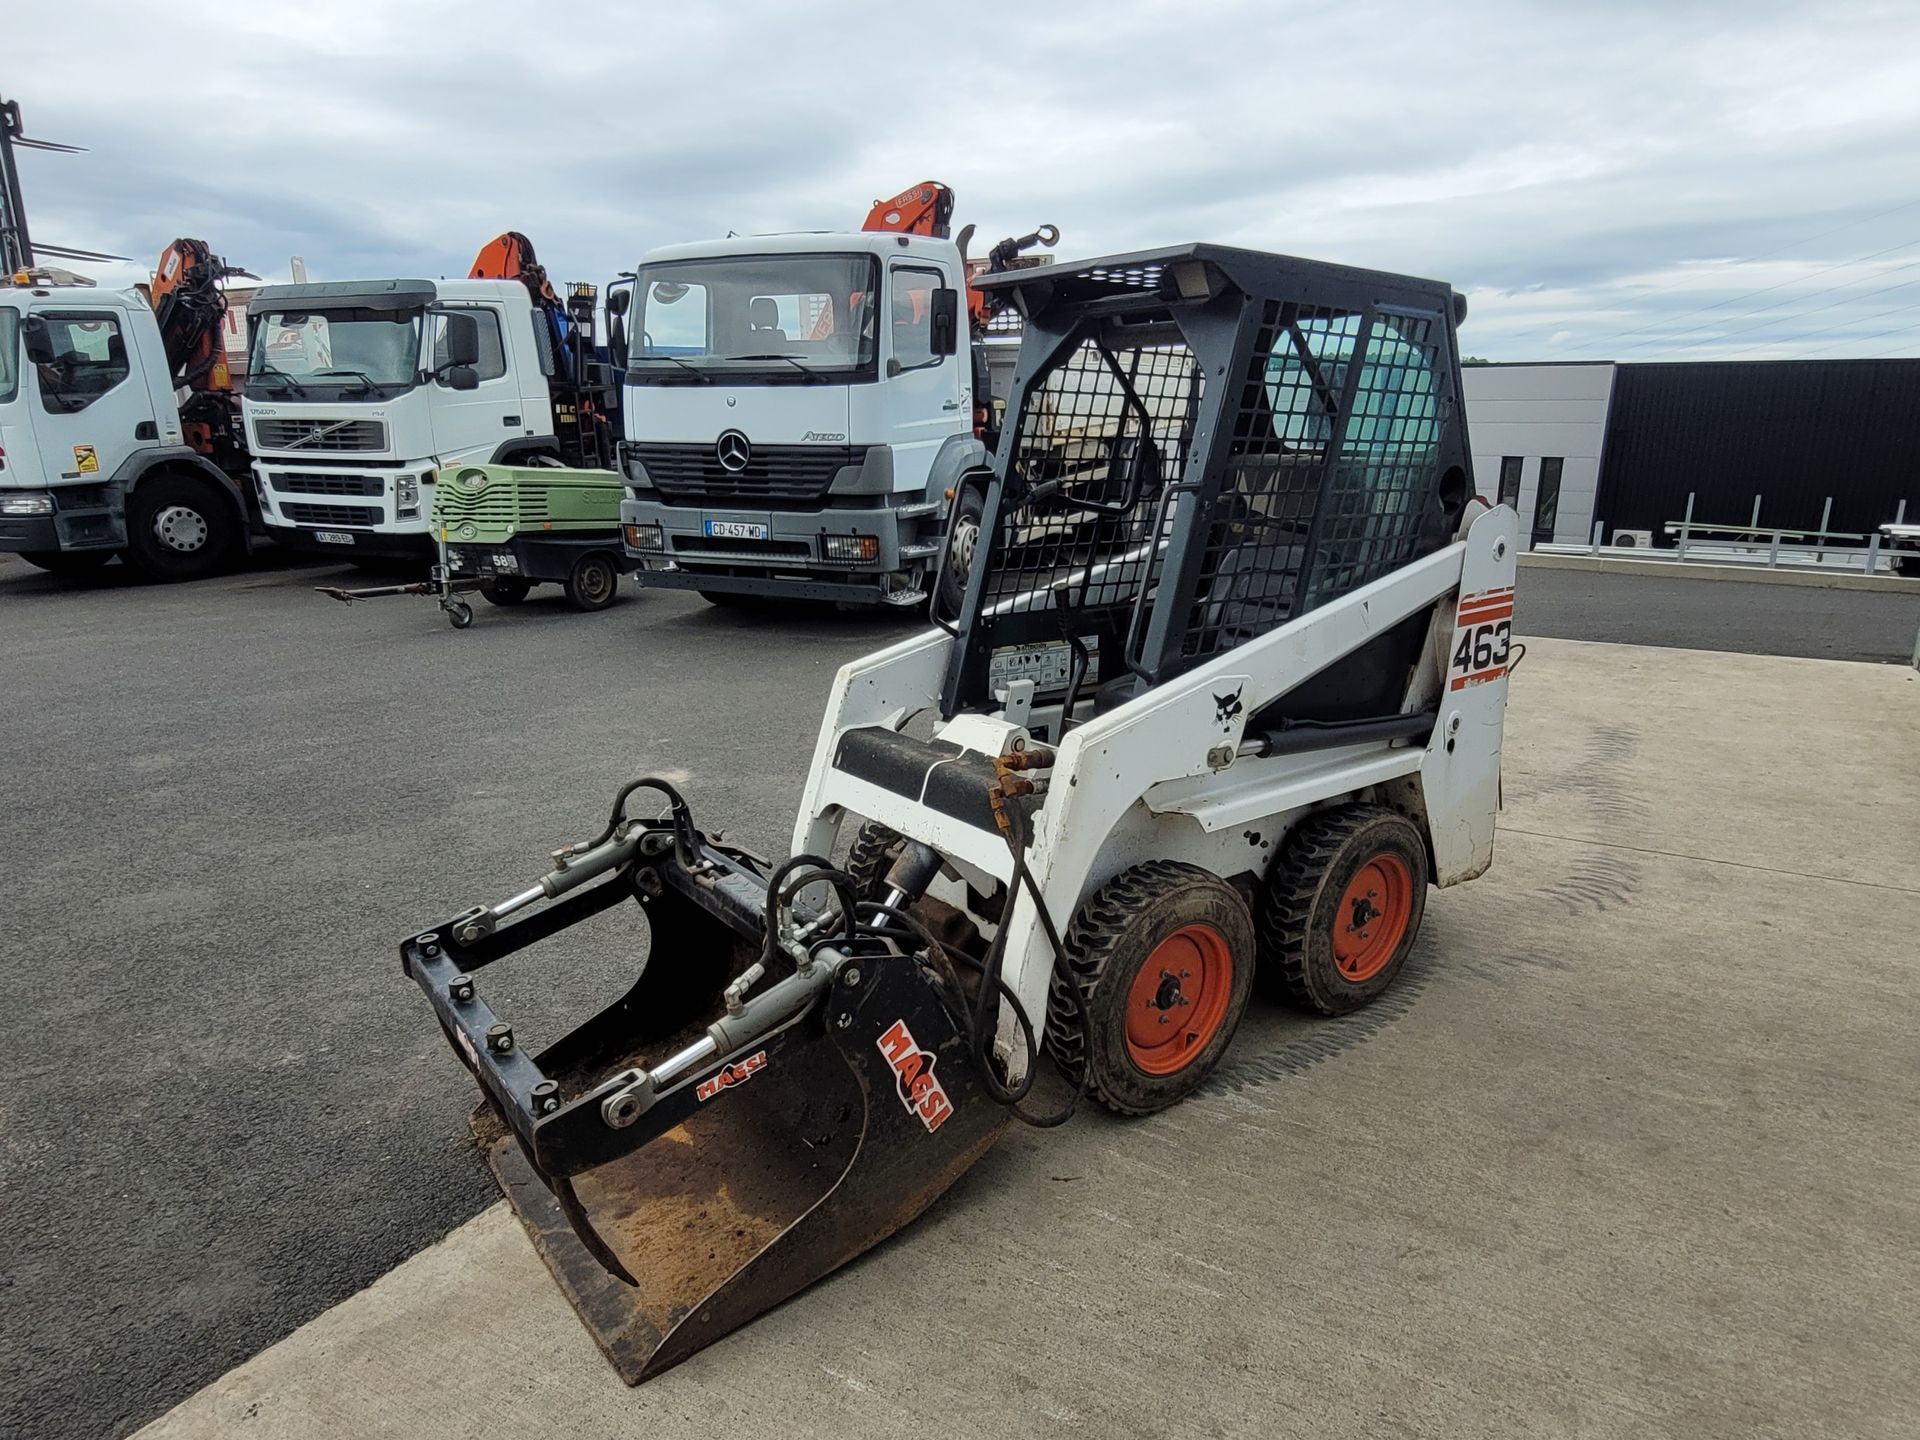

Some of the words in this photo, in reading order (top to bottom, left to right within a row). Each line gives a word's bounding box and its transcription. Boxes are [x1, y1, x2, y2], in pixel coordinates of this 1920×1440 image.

[250, 408, 277, 416] VOLVO
[492, 554, 509, 567] 58
[1452, 620, 1512, 674] 463
[697, 1052, 767, 1101] MAGSI
[879, 1021, 953, 1131] MAGSI
